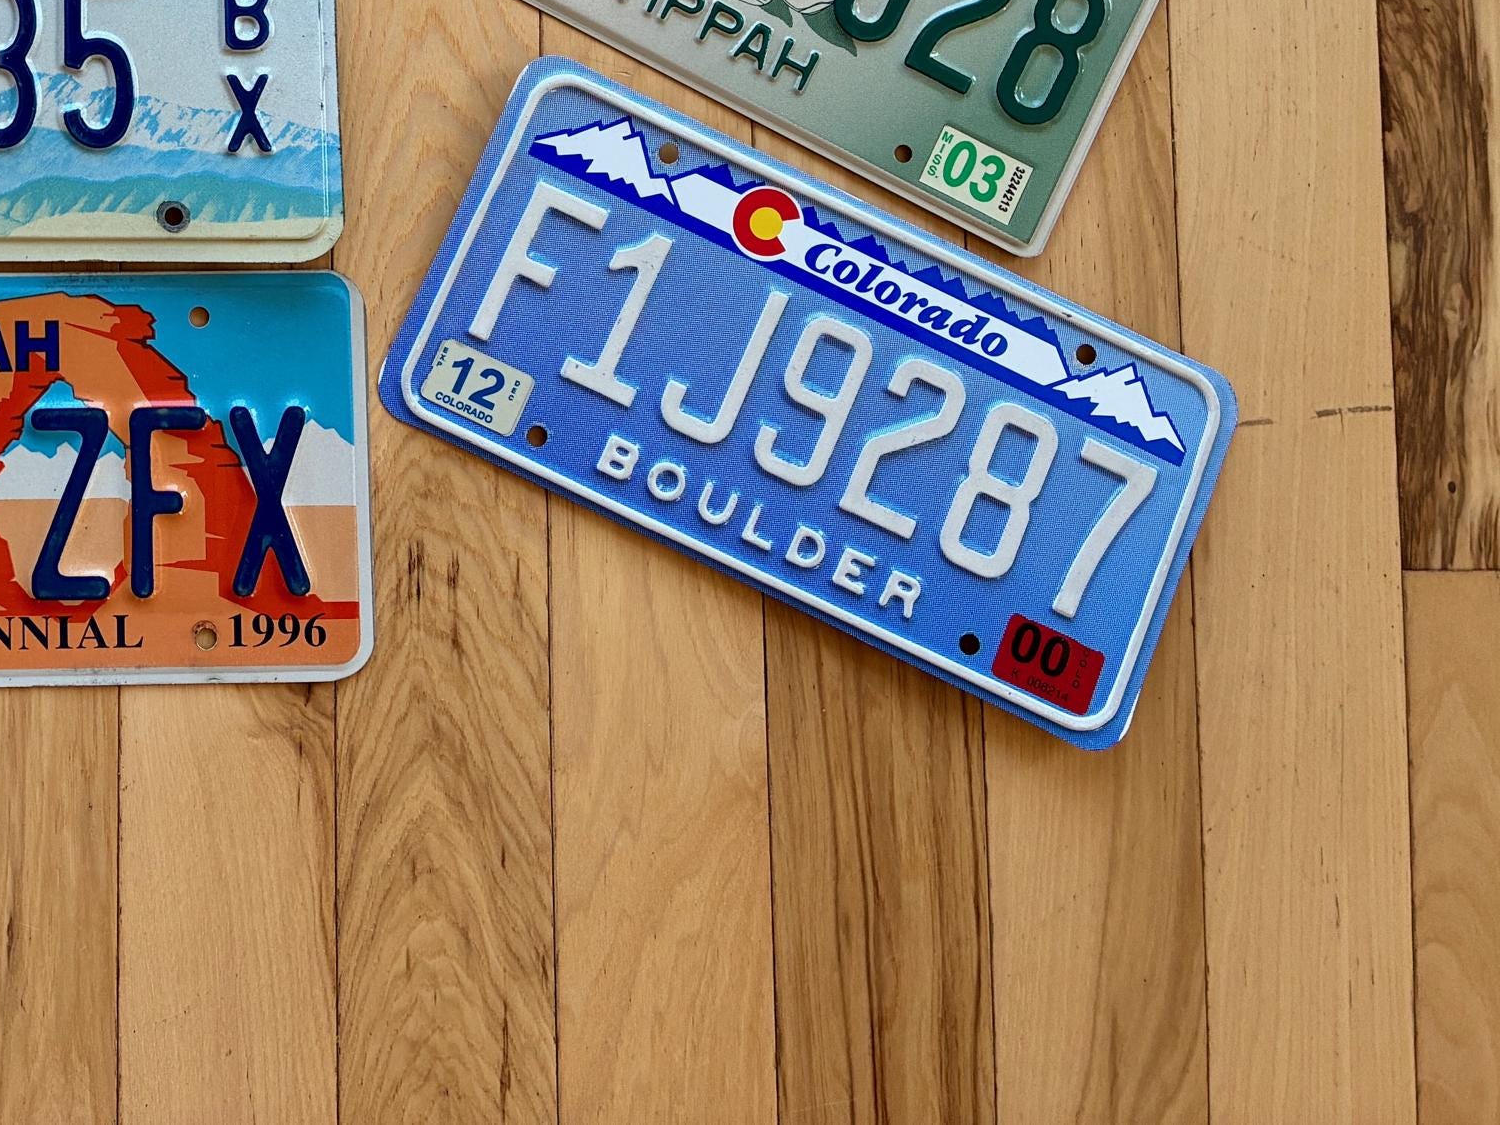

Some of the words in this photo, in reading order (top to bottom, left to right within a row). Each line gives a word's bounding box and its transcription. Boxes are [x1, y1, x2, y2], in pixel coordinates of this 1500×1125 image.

[943, 141, 1006, 202] 03
[998, 166, 1025, 212] 32244213
[804, 243, 1009, 357] Colorado
[435, 392, 493, 423] COLORADO
[452, 357, 505, 410] 12
[468, 179, 1157, 618] F1J9287
[508, 380, 521, 401] DEC
[31, 405, 311, 601] ZFX
[597, 435, 922, 618] BOULDER
[227, 612, 327, 650] 1996
[1012, 623, 1070, 677] 00
